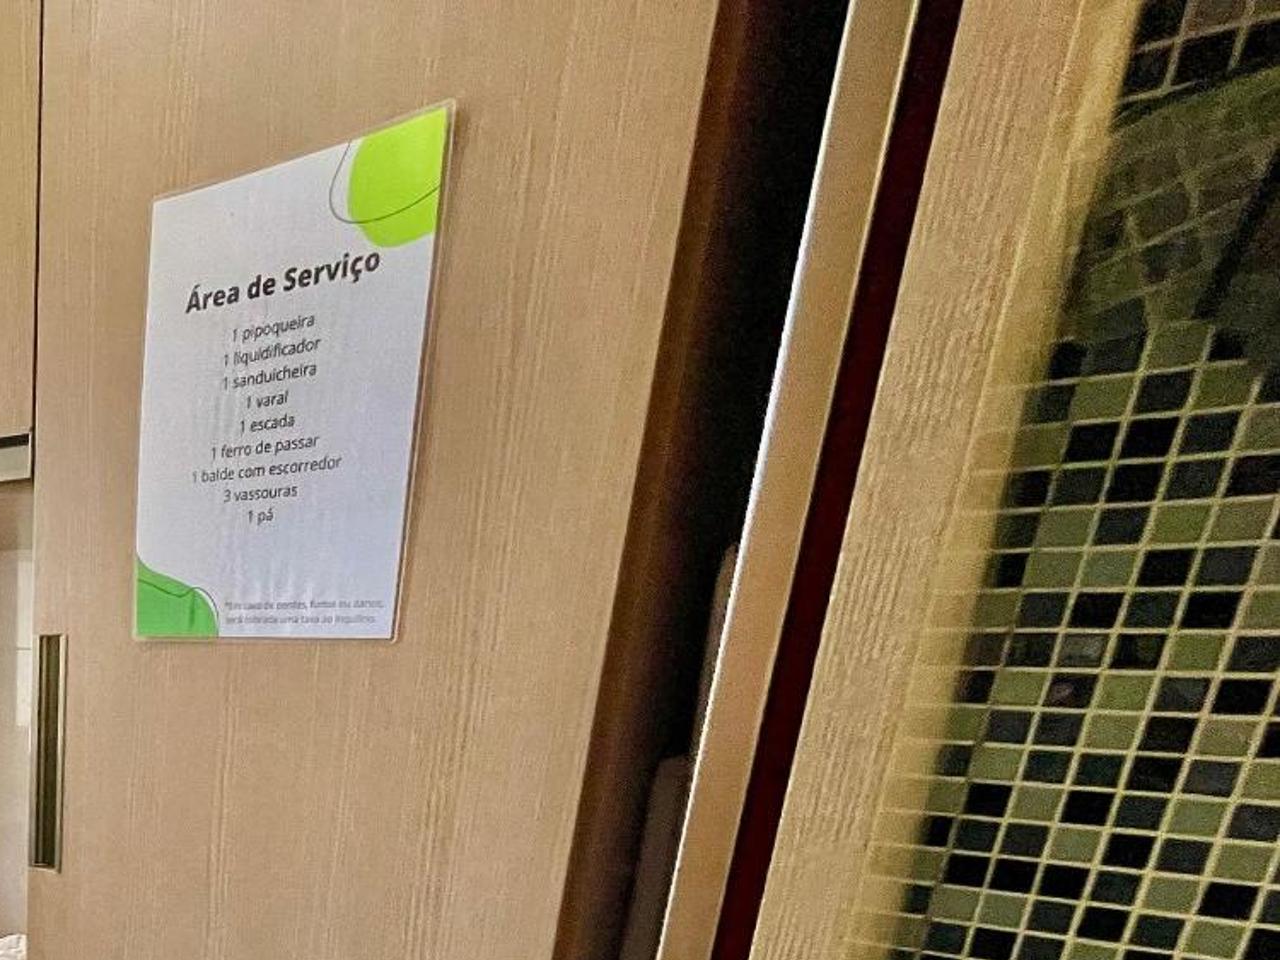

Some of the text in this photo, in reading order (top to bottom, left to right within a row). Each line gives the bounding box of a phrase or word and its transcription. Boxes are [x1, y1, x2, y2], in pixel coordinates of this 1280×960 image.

[185, 252, 380, 314] Área de Serviço
[232, 315, 315, 343] 1 pipoqueira
[224, 338, 322, 366] 1 liquidificador
[224, 364, 317, 390] 1 sanduicheira
[246, 390, 289, 408] 1 varal
[240, 414, 296, 436] 1 escada
[212, 436, 320, 460] 1 ferro de passar
[201, 467, 235, 483] balde
[238, 466, 266, 479] com
[269, 455, 343, 476] escorredor
[223, 486, 299, 503] 3 vassouras
[248, 508, 274, 525] 1 pá
